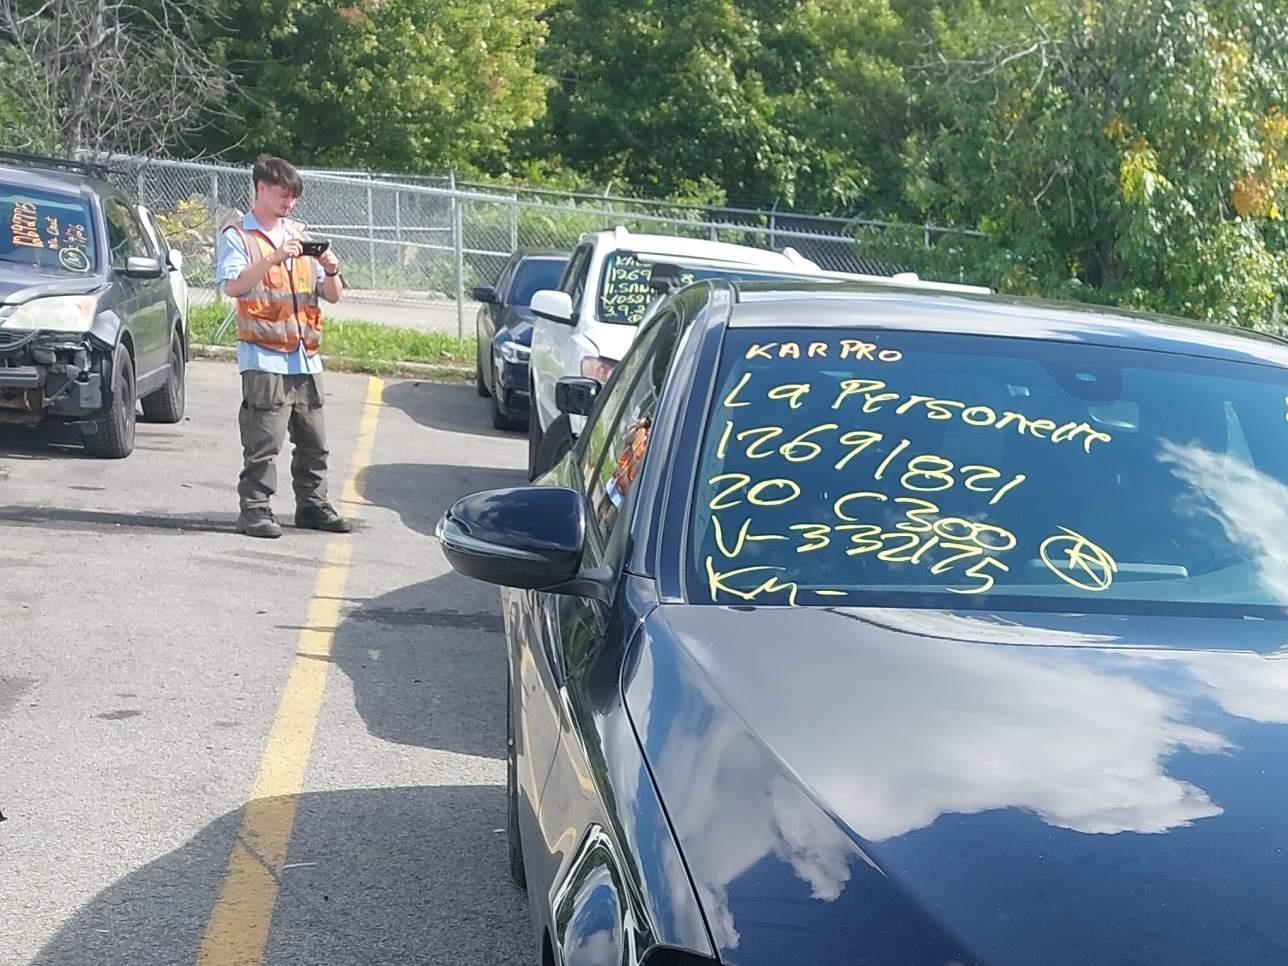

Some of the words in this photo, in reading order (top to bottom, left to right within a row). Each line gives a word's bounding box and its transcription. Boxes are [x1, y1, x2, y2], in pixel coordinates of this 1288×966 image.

[745, 342, 829, 360] KAR
[839, 339, 903, 362] PRO
[723, 372, 811, 409] La
[716, 420, 1026, 505] 12691821
[708, 472, 801, 510] 20
